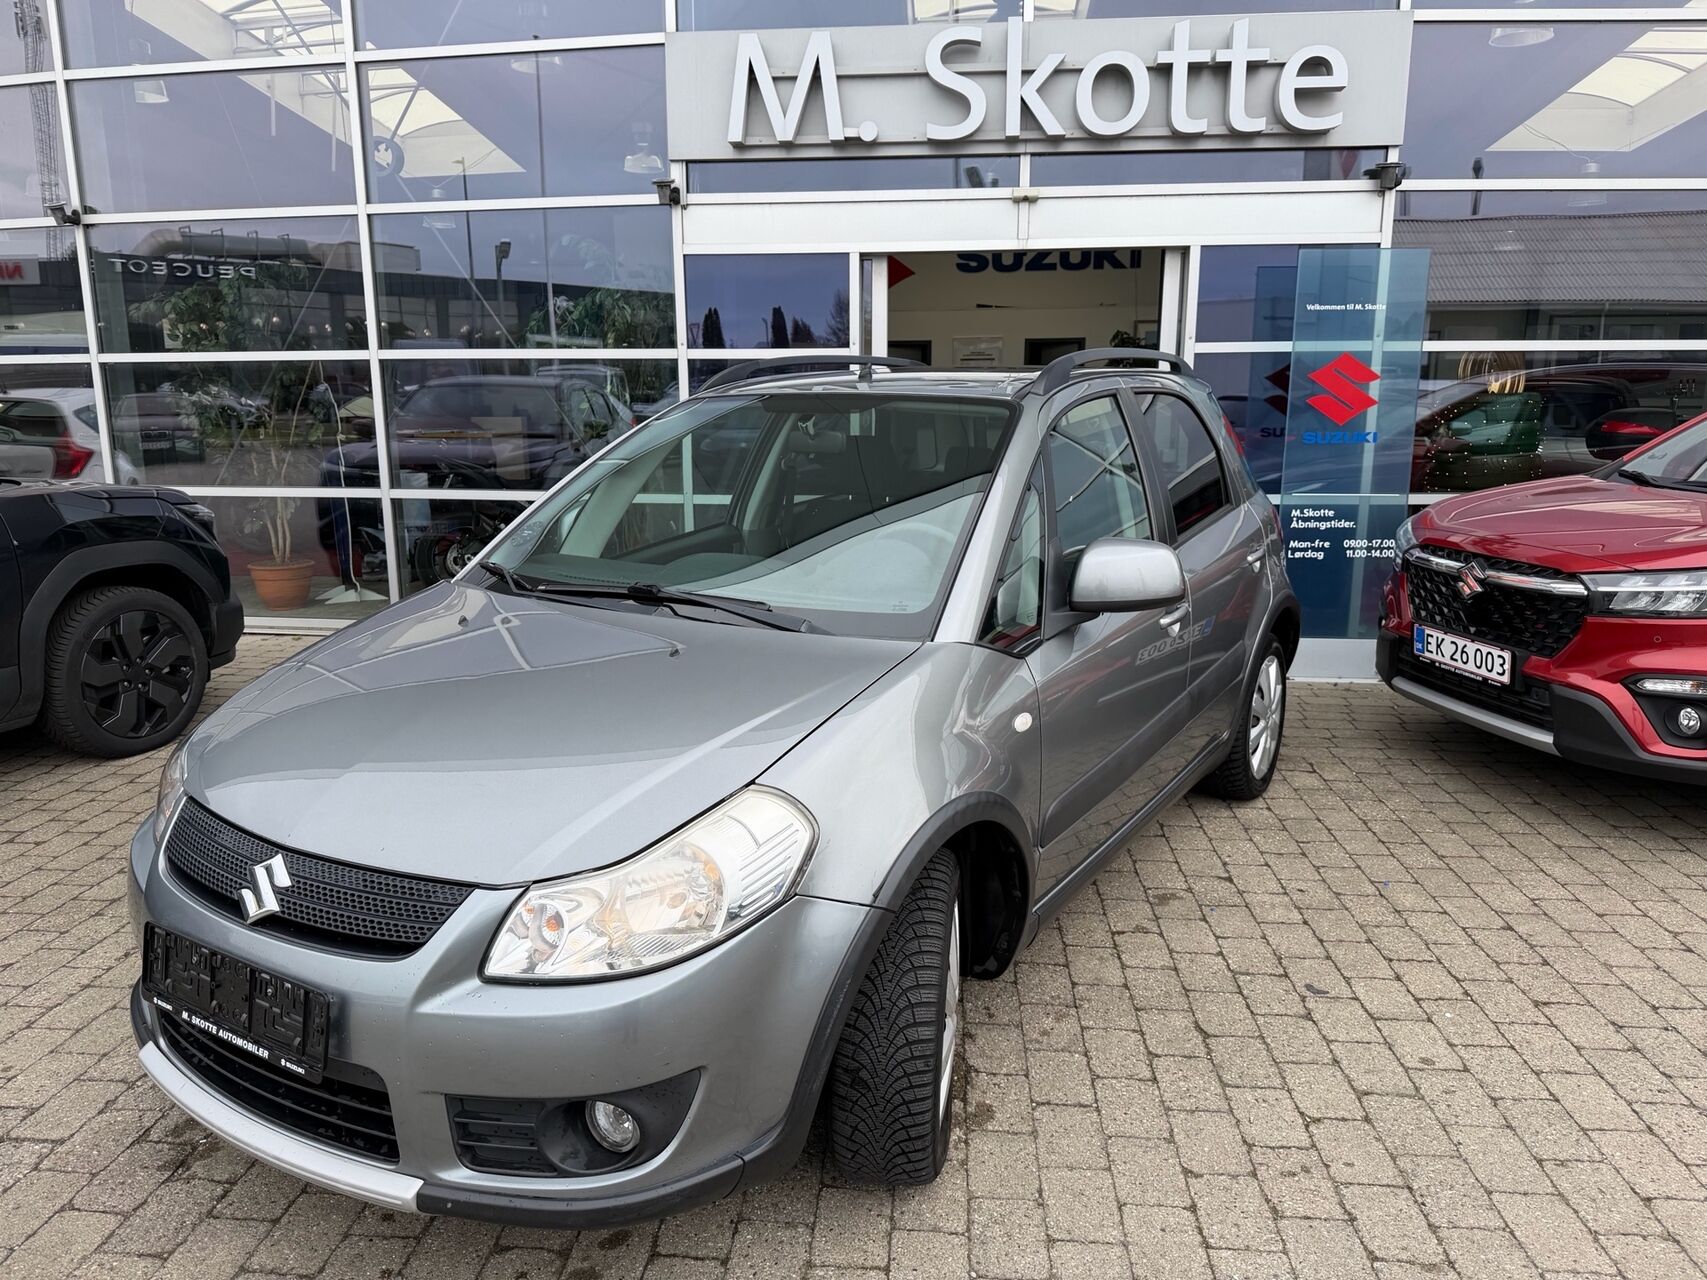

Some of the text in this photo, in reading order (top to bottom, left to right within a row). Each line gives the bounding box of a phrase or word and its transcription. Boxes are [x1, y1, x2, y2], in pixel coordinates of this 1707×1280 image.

[727, 15, 1349, 148] M. Skotte
[956, 249, 1142, 273] SUZUKI
[1306, 303, 1346, 311] Velkommen
[1346, 303, 1354, 311] til
[1364, 303, 1387, 311] Skotte
[1302, 432, 1378, 445] SUZUKI
[1291, 508, 1335, 517] M.Skotte
[1290, 518, 1356, 530] Åbningstider.
[1288, 539, 1396, 549] Man-fre 09.00-17.00
[1287, 549, 1395, 560] Lørdag 11.00-14.00
[1425, 633, 1506, 676] EK 26 003
[182, 1011, 269, 1059] M. SKOTTE AUTOMOBILER
